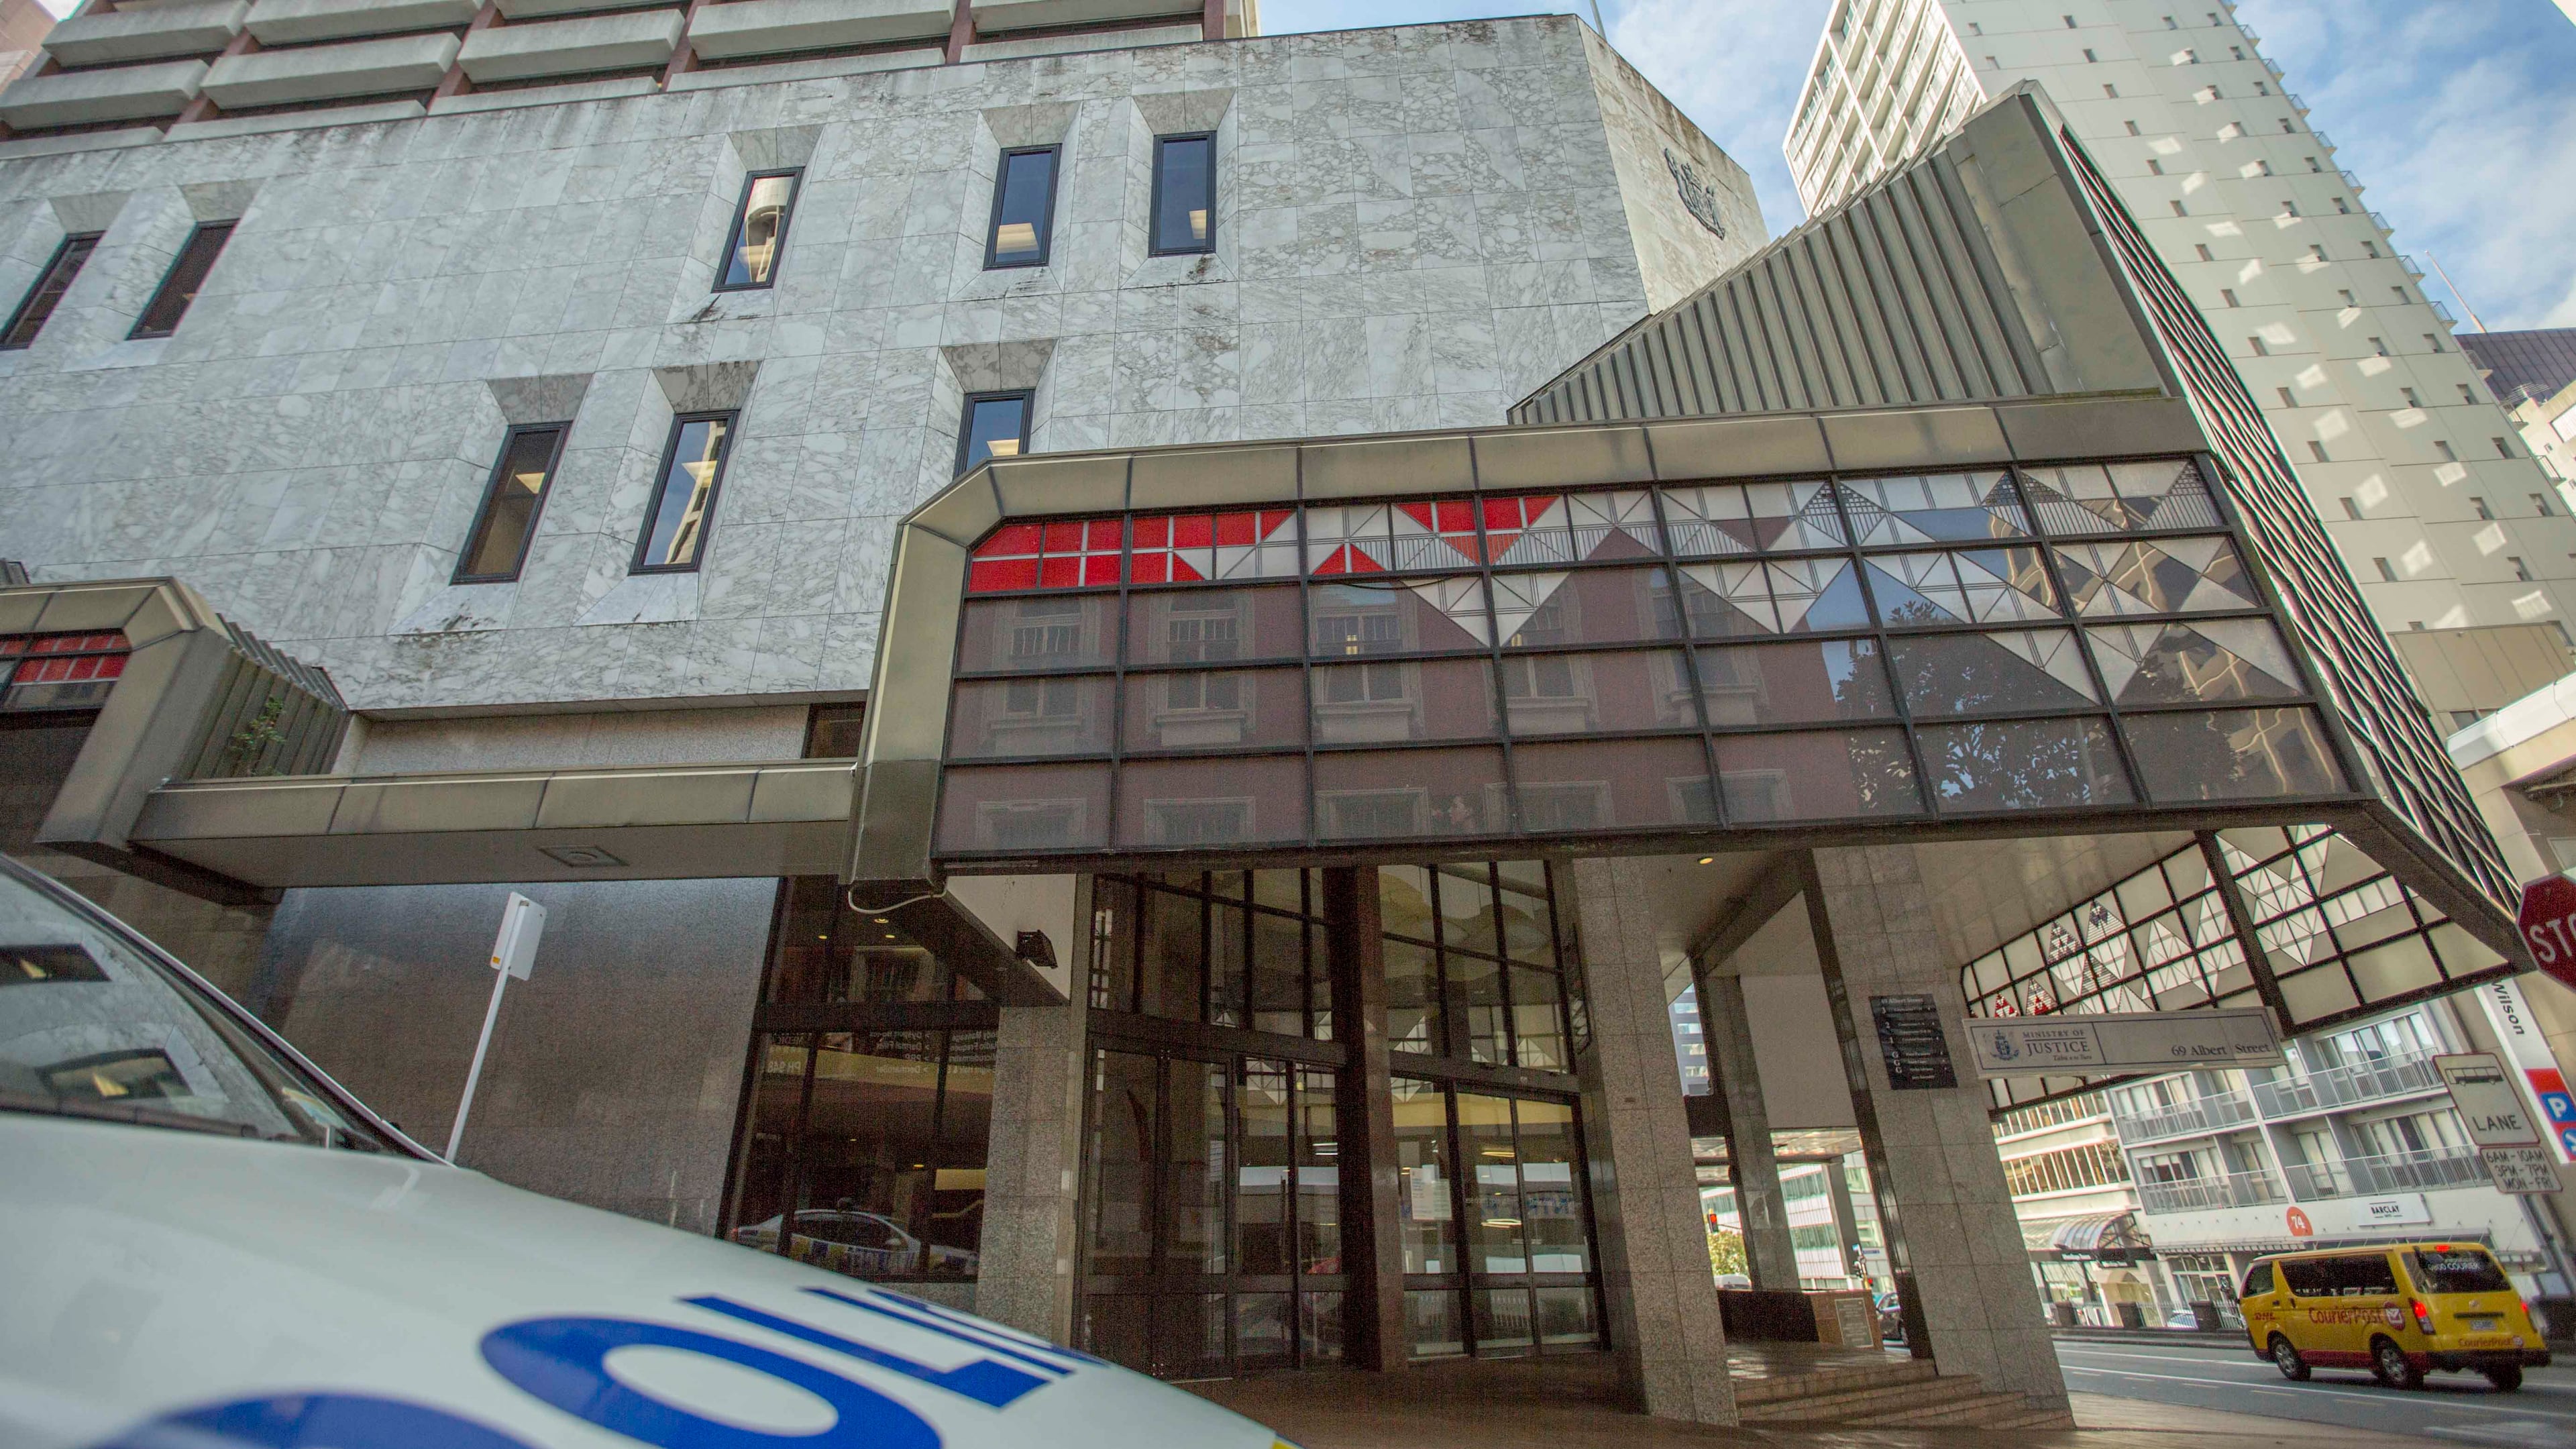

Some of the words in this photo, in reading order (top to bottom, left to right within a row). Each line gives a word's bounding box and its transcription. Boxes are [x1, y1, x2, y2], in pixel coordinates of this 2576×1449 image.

[2530, 913, 2576, 963] ST
[2491, 982, 2525, 1035] Wilson
[2025, 1041, 2090, 1057] JUSTICE
[2171, 1044, 2187, 1057] 69
[2190, 1044, 2228, 1056] Albert
[2234, 1043, 2271, 1054] Street
[2548, 1097, 2567, 1118] P
[2471, 1115, 2522, 1131] LANE
[2370, 1205, 2400, 1214] BARCLAY
[2291, 1216, 2306, 1230] 74
[2254, 1311, 2276, 1321] DHL
